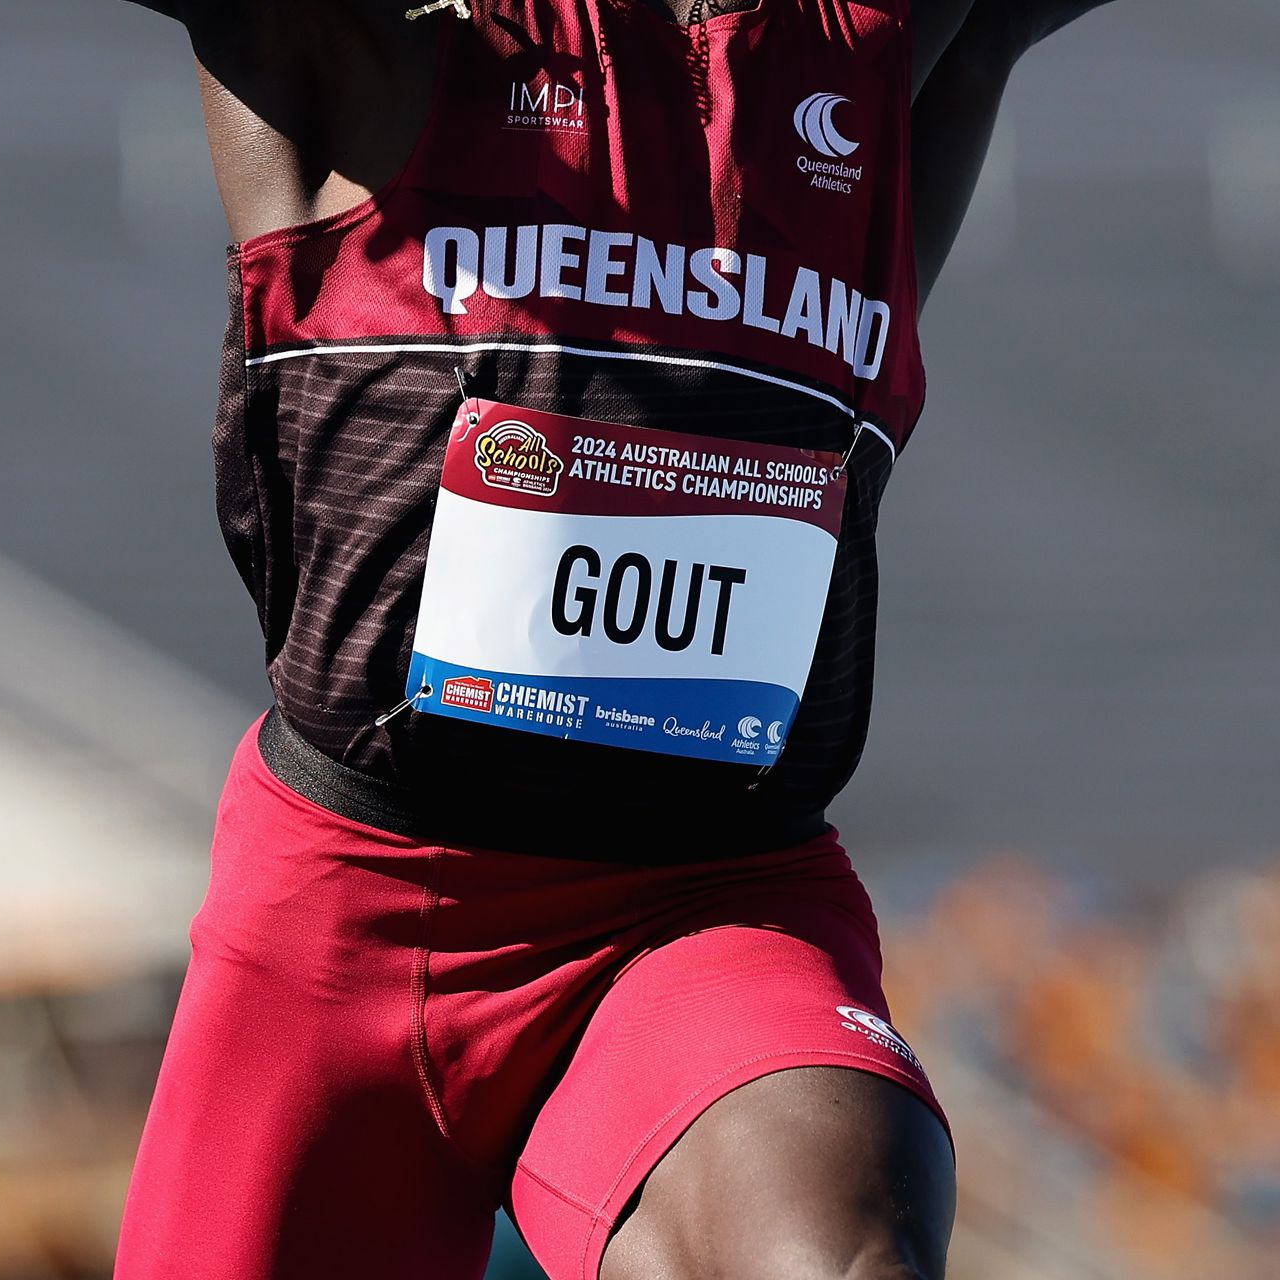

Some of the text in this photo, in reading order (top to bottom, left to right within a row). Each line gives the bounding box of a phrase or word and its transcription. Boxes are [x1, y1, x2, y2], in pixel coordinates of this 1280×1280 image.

[510, 82, 583, 116] IMPI
[507, 115, 584, 129] SPORTSWEAR
[796, 155, 862, 180] Queensland
[810, 174, 852, 194] Athletics
[422, 224, 890, 381] QUEENSLAND
[479, 437, 558, 474] Schools
[518, 436, 541, 452] All
[571, 435, 827, 486] 2024 AUSTRALIAN ALL SCHOOLS
[493, 467, 551, 483] CHAMPIONSHIPS
[568, 458, 823, 510] ATHLETICS CHAMPIONSHIPS
[551, 544, 747, 656] GOUT
[445, 694, 488, 708] WAREHOUSE
[446, 684, 491, 701] CHEMIST
[496, 682, 589, 716] CHEMIST
[495, 704, 583, 729] WAREHOUSE
[595, 706, 656, 727] brisbane
[605, 721, 643, 732] australia
[663, 716, 727, 741] Queensland
[731, 738, 760, 750] Athletics
